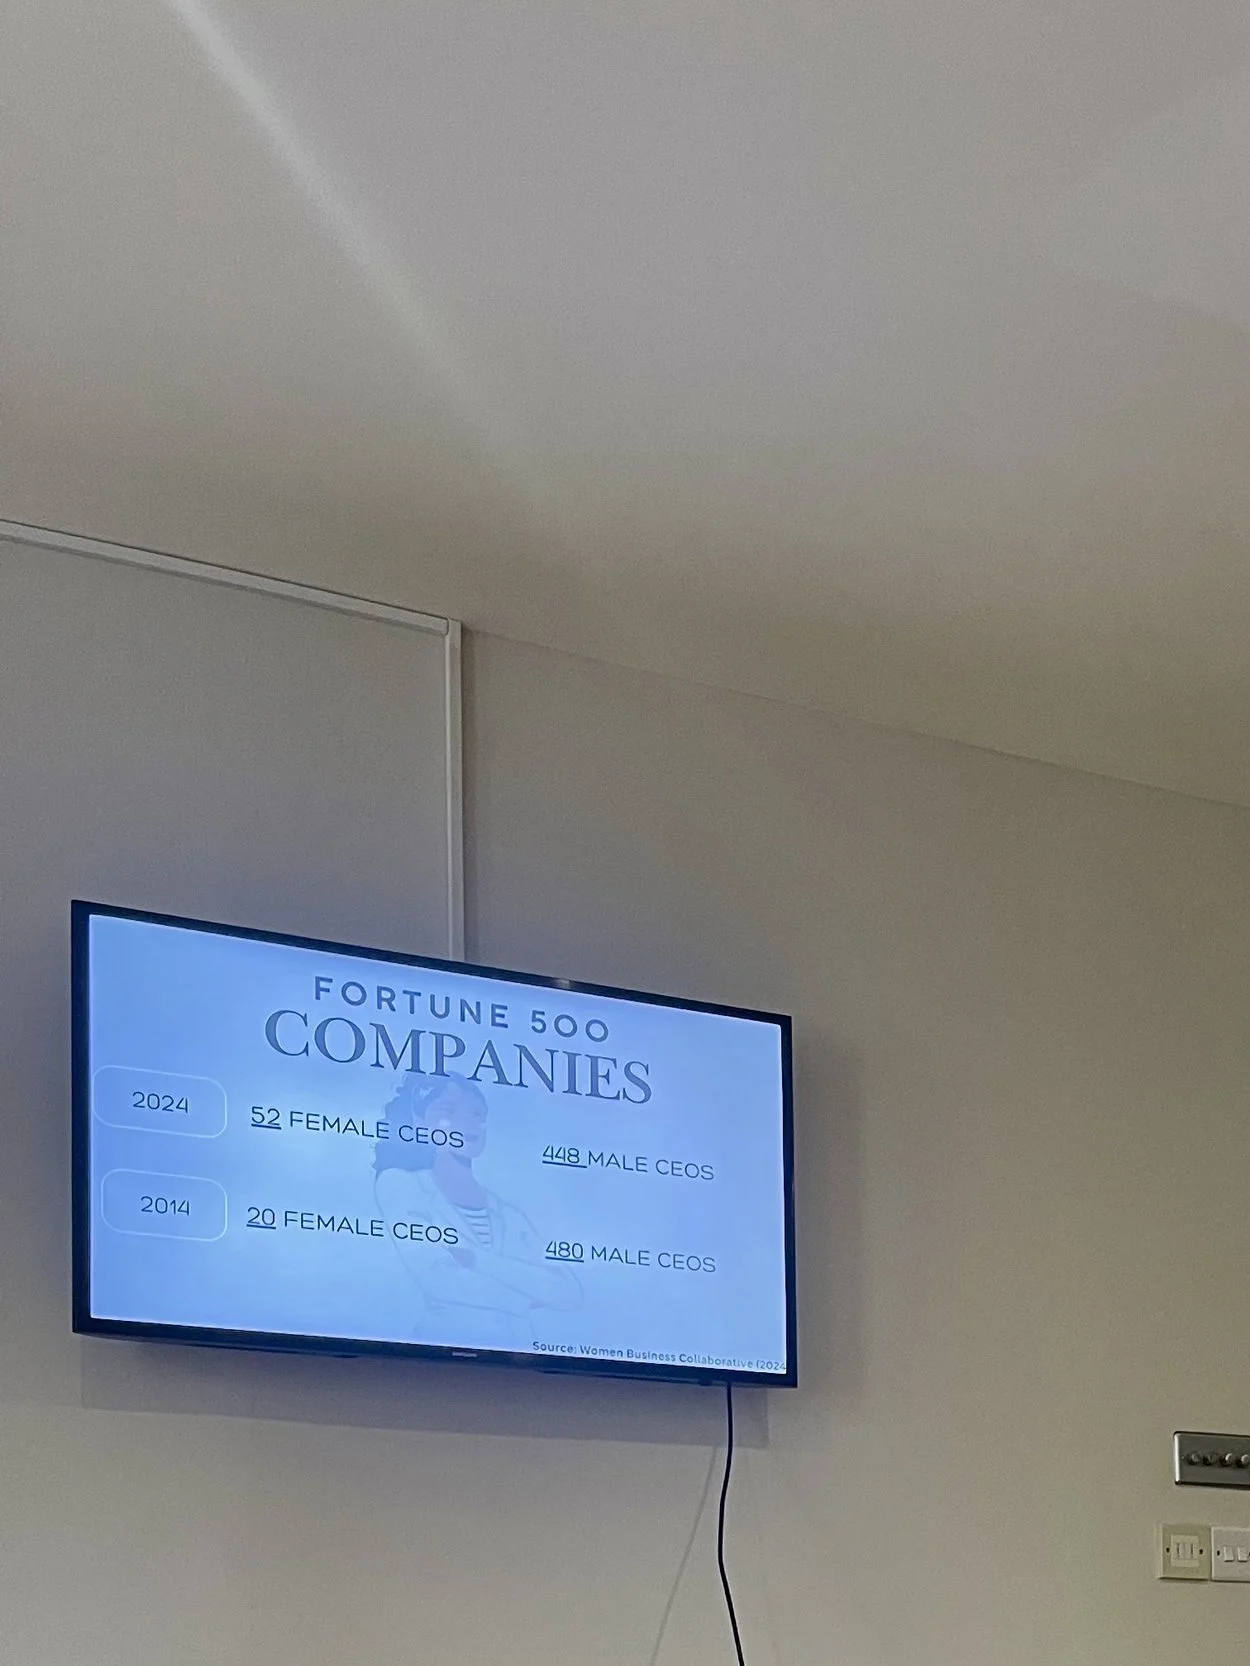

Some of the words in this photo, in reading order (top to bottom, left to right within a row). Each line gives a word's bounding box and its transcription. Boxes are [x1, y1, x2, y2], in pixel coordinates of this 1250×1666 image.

[314, 975, 510, 1029] FORTUNE
[530, 1010, 609, 1043] 500
[264, 1009, 653, 1105] COMPANIES
[132, 1091, 189, 1114] 2024
[250, 1106, 281, 1130] 52
[289, 1110, 390, 1140] FEMALE
[398, 1124, 465, 1149] CEOS
[542, 1145, 582, 1167] 448
[588, 1150, 648, 1173] MALE
[655, 1159, 715, 1181] CEOS
[140, 1195, 190, 1217] 2014
[246, 1206, 277, 1230] 20
[283, 1210, 385, 1238] FEMALE
[392, 1221, 459, 1245] CEOS
[545, 1240, 584, 1263] 480
[591, 1245, 651, 1267] MALE
[657, 1252, 717, 1273] CEOS
[532, 1340, 577, 1355] Source:
[579, 1344, 624, 1358] Women
[626, 1348, 677, 1362] Business
[678, 1353, 755, 1369] Collaborative
